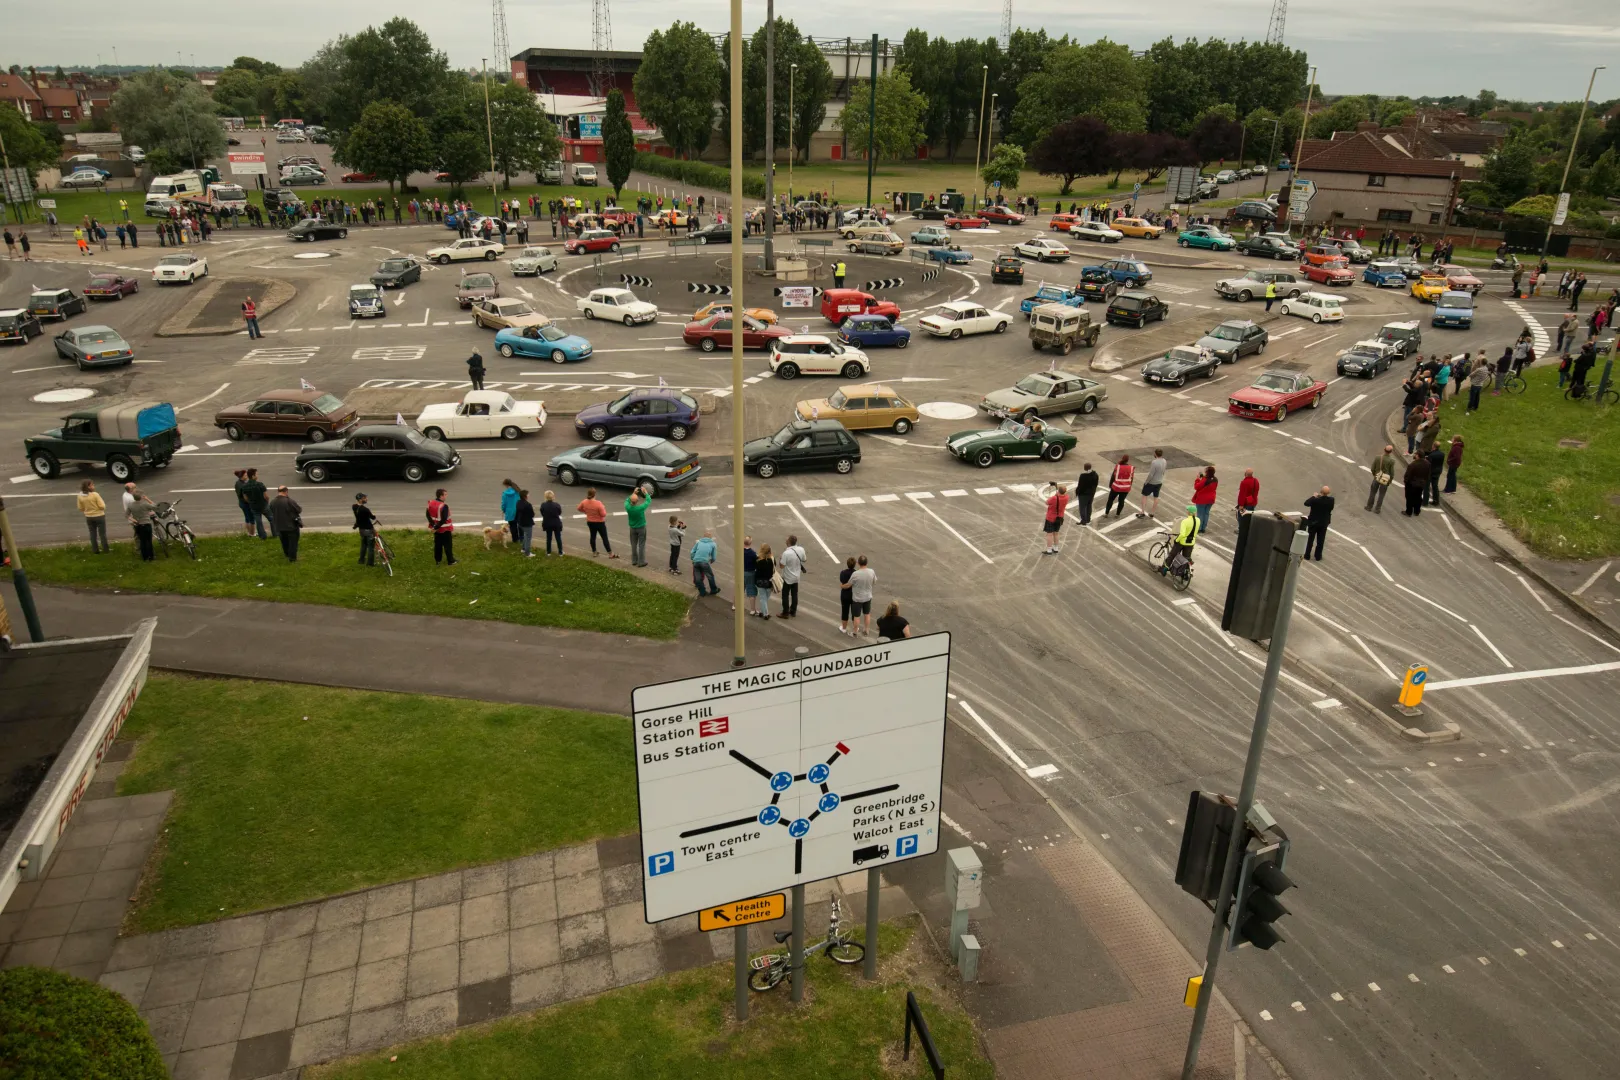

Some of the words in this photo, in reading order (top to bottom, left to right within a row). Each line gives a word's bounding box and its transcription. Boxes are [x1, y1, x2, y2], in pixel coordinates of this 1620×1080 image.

[702, 680, 732, 696] THE
[737, 670, 787, 689] MAGIC
[791, 650, 892, 679] ROUNDABOUT
[641, 713, 683, 729] Gorse
[689, 706, 713, 720] Hill
[642, 727, 694, 745] Station
[58, 771, 88, 837] FIRE
[95, 681, 138, 768] STATION
[643, 752, 670, 764] Bus
[674, 740, 725, 757] Station
[853, 792, 926, 815] Greenbridge
[852, 825, 894, 841] Walcot
[899, 818, 924, 831] East
[853, 813, 886, 828] Parks
[681, 842, 715, 857] Town
[719, 831, 761, 847] centre
[705, 847, 735, 862] East
[901, 836, 915, 855] P
[654, 855, 671, 874] P
[734, 909, 771, 922] Centre
[735, 899, 771, 912] Health
